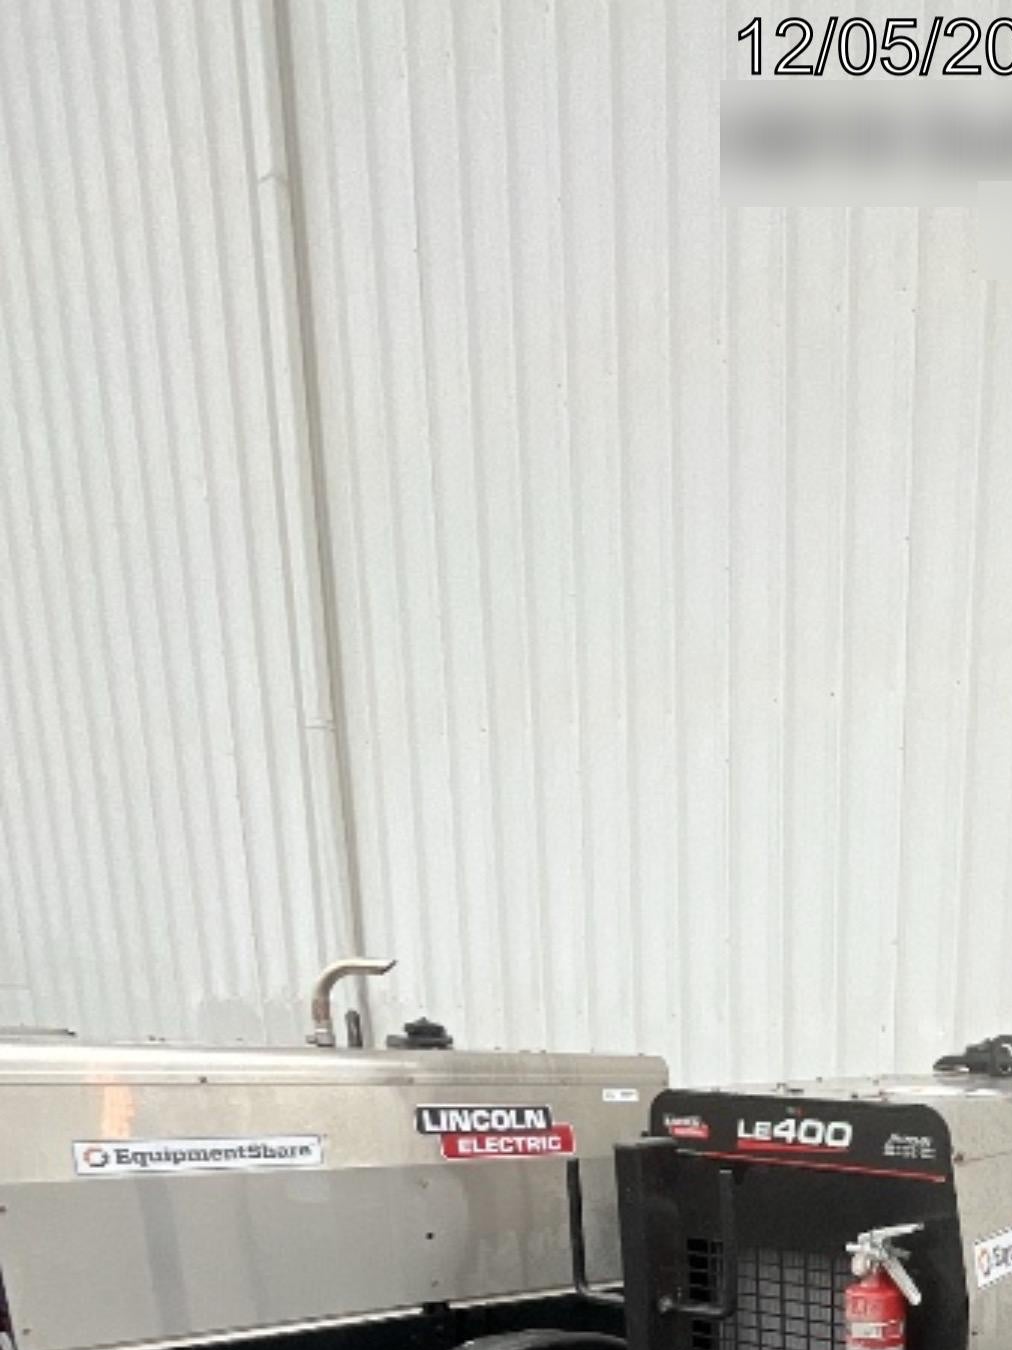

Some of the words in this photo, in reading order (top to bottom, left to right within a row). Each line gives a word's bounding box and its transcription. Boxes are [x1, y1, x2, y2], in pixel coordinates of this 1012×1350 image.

[422, 1108, 548, 1132] LINCOLN
[457, 1134, 563, 1155] ELECTRIC
[736, 1118, 854, 1148] LE400
[114, 1142, 313, 1168] EquipmentShare
